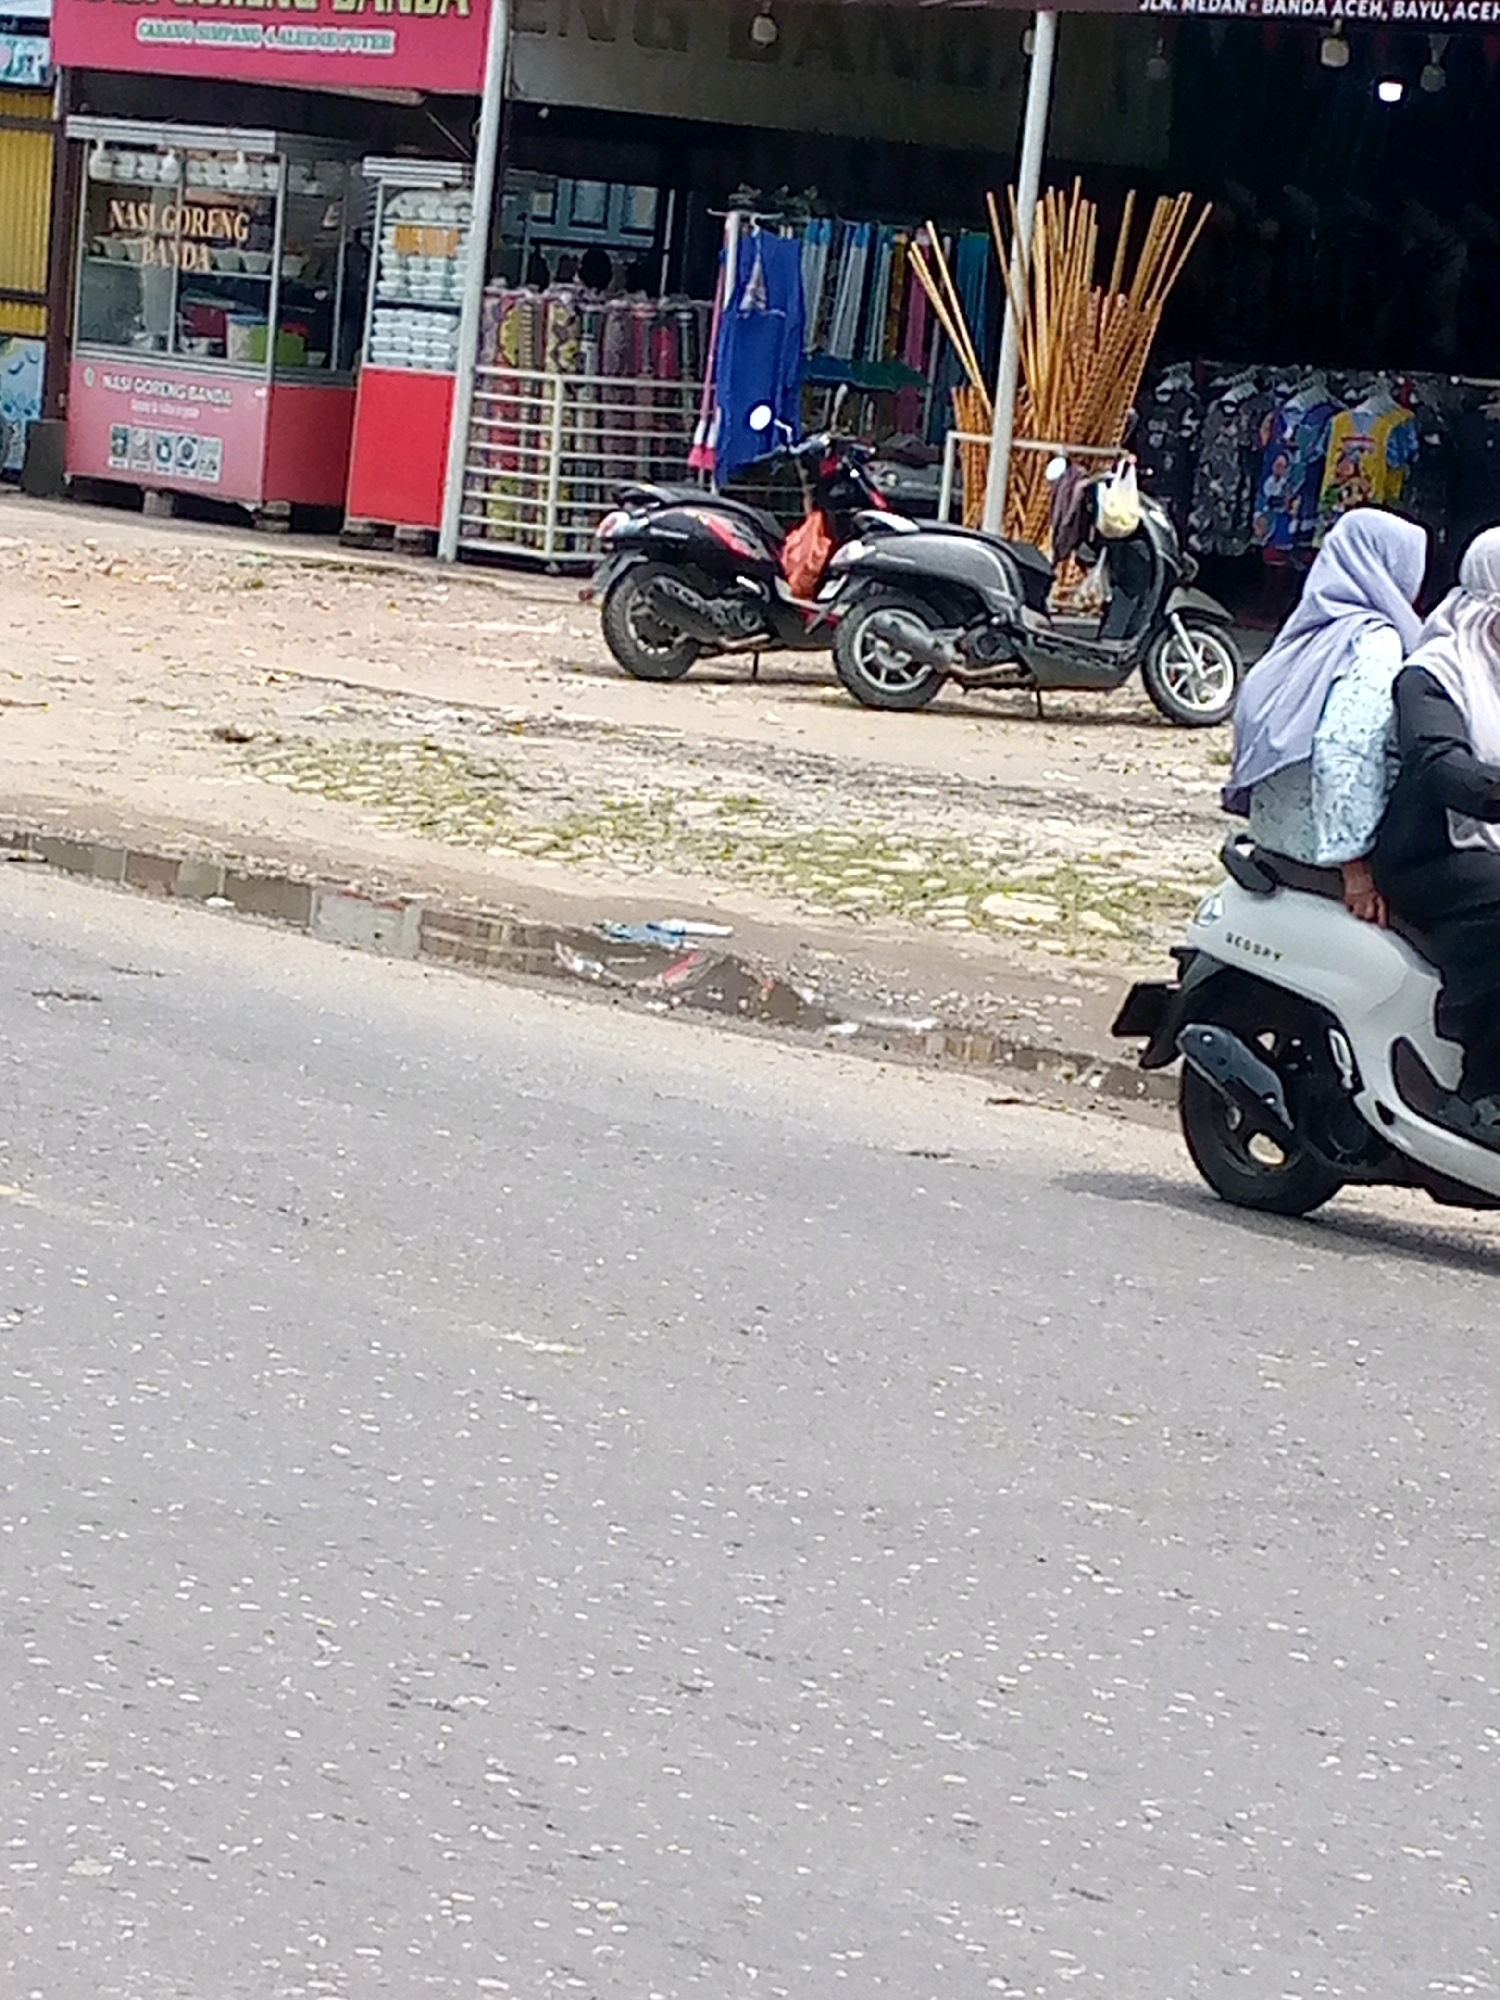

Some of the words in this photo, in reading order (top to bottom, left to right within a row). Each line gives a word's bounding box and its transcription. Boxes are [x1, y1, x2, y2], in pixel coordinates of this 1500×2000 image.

[1262, 0, 1328, 16] BANDA
[1331, 0, 1389, 22] ACEH,
[1393, 0, 1450, 23] BAYU,
[109, 199, 156, 232] NASI
[161, 204, 250, 242] GORENG
[141, 235, 212, 274] BANDA
